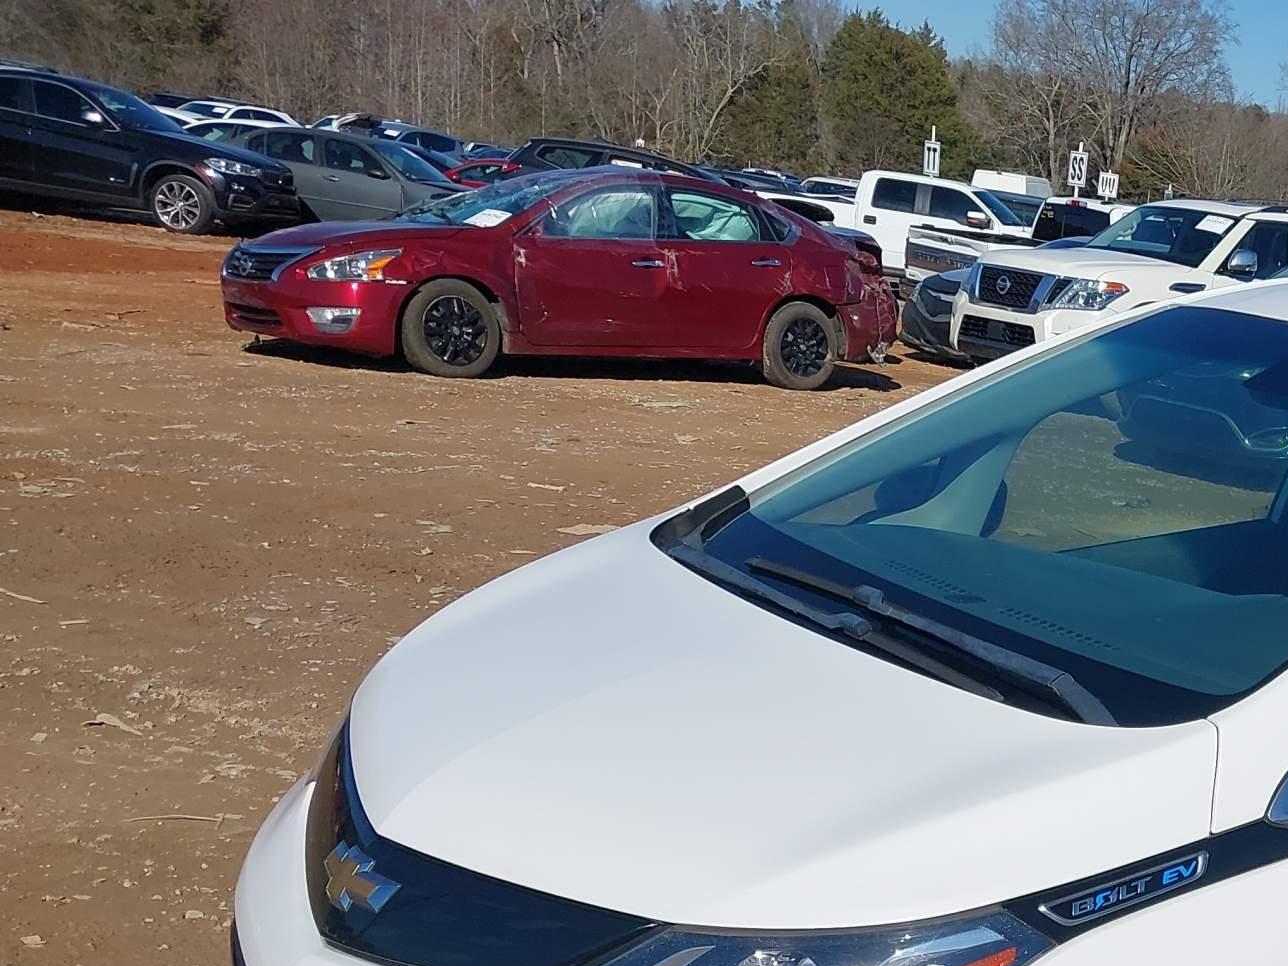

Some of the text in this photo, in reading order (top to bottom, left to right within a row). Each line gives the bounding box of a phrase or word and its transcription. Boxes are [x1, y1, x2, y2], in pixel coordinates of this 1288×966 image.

[1070, 155, 1085, 181] SS
[1071, 860, 1197, 917] BOLT EV
